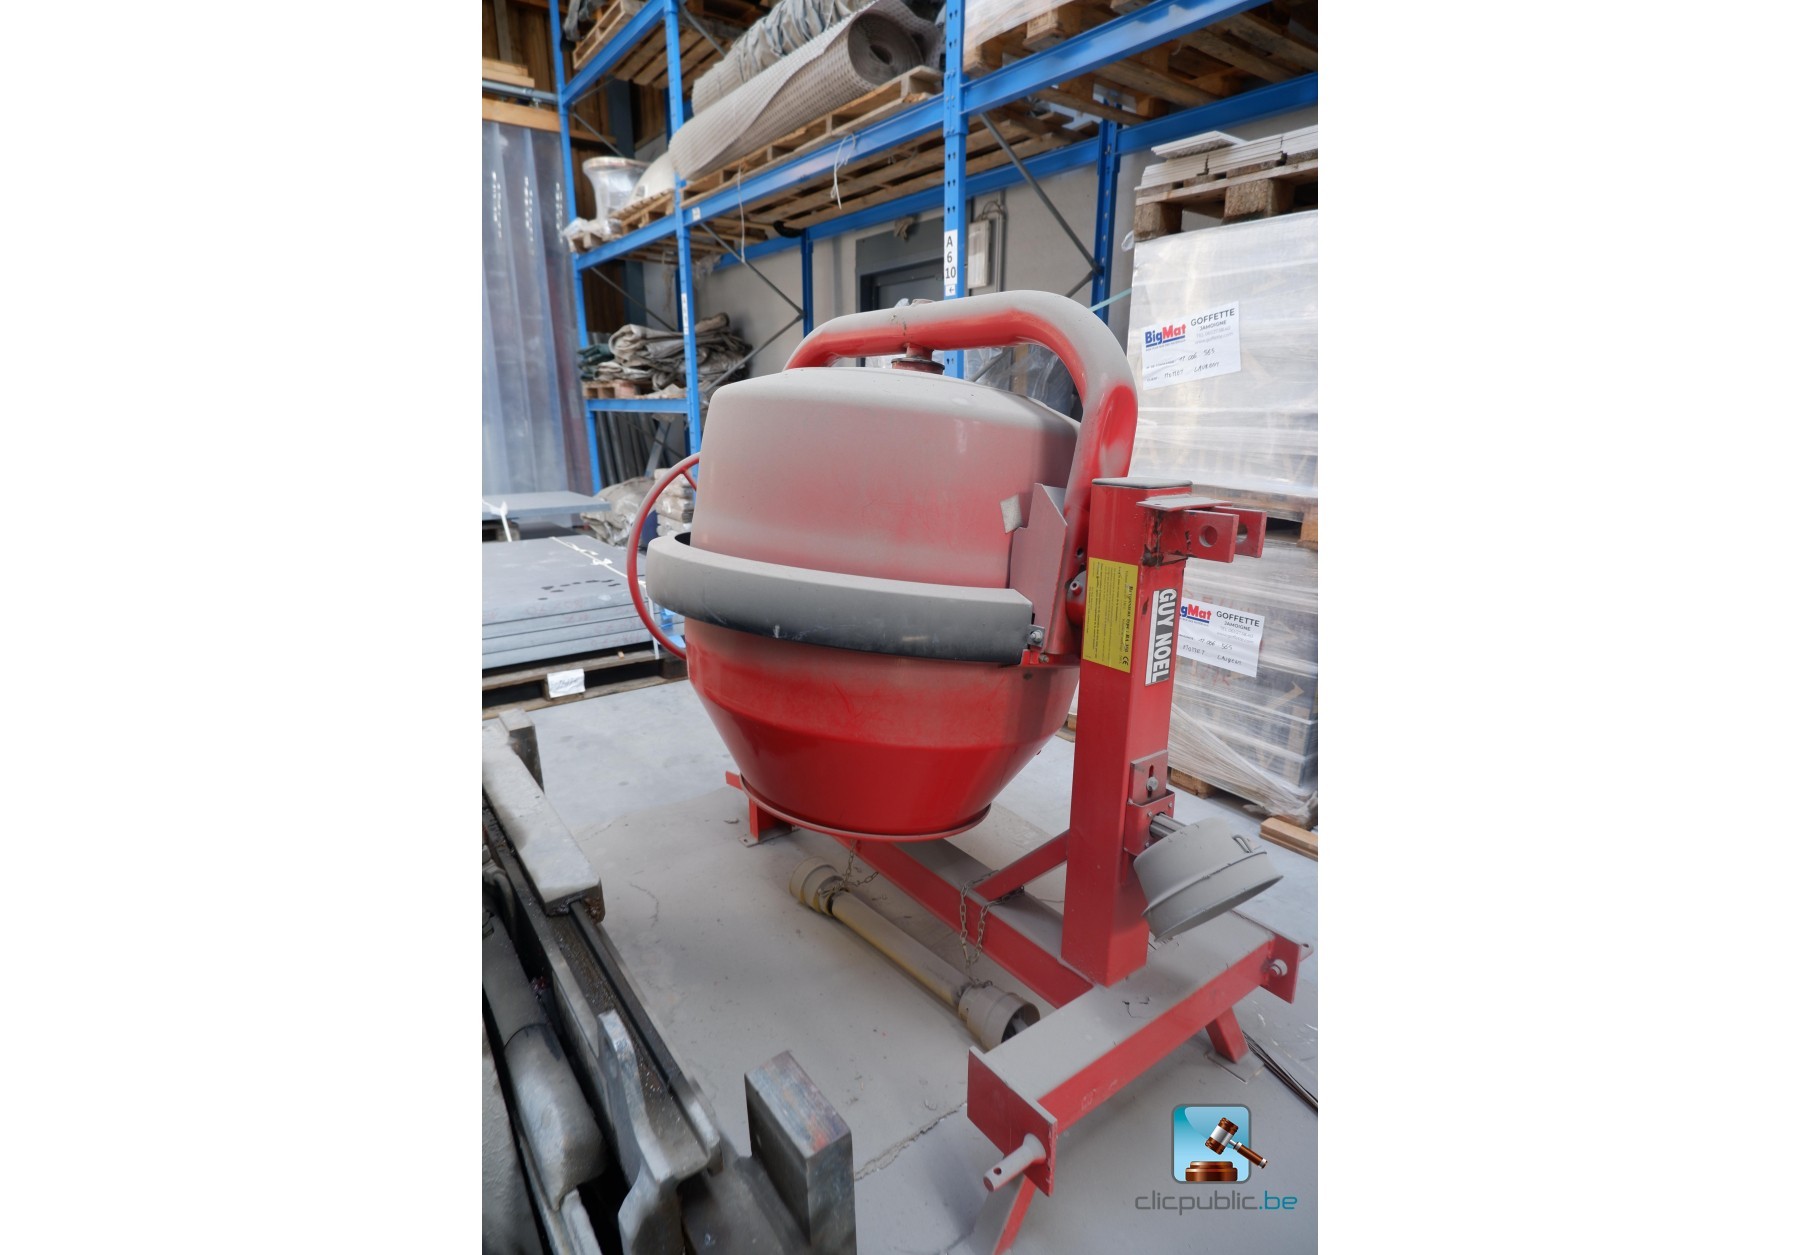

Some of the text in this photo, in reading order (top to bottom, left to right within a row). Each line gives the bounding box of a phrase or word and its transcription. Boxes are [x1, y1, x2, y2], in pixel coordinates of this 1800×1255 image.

[946, 235, 953, 247] A
[946, 251, 953, 263] 6
[945, 266, 957, 279] 10
[1190, 308, 1235, 327] GOFFETTE
[1145, 324, 1187, 345] BigMat
[1180, 603, 1212, 620] gMat
[1216, 610, 1260, 627] GOFFETTE
[1152, 588, 1177, 682] GUY NOEL
